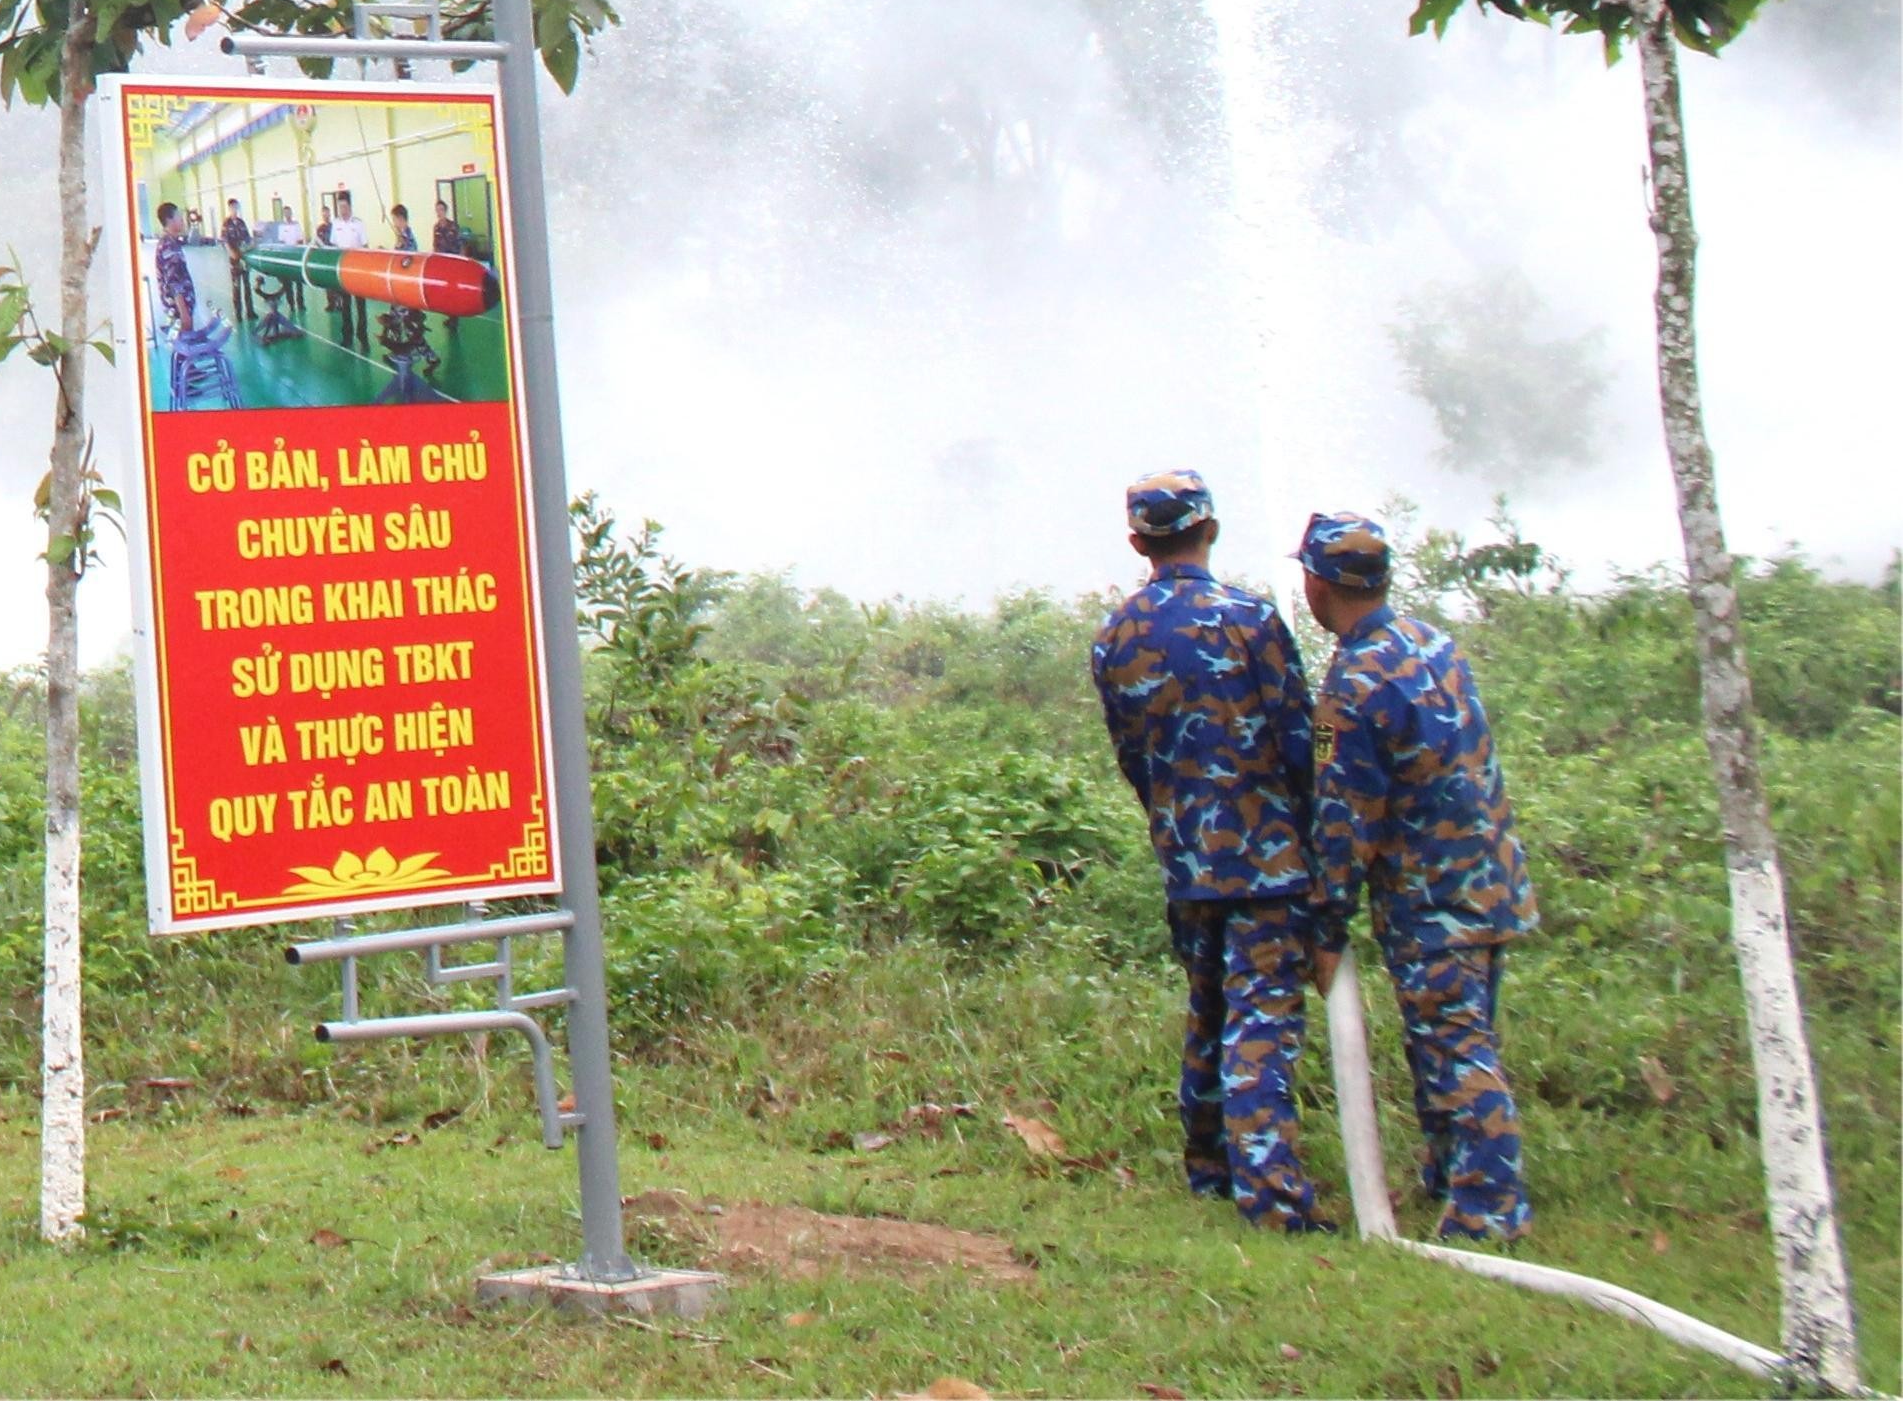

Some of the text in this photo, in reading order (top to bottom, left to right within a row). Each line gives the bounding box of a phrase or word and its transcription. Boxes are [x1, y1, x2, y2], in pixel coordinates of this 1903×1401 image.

[187, 429, 488, 493] CỞ BẢN, LÀM CHỦ
[237, 503, 452, 560] CHUYÊN SÂU
[194, 566, 497, 631] TRONG KHAI THÁC
[231, 640, 474, 700] SỬ DỤNG TBKT
[239, 701, 474, 766] VÀ THỰC HIỆN
[209, 765, 511, 843] QUY TẮC AN TOÀN
